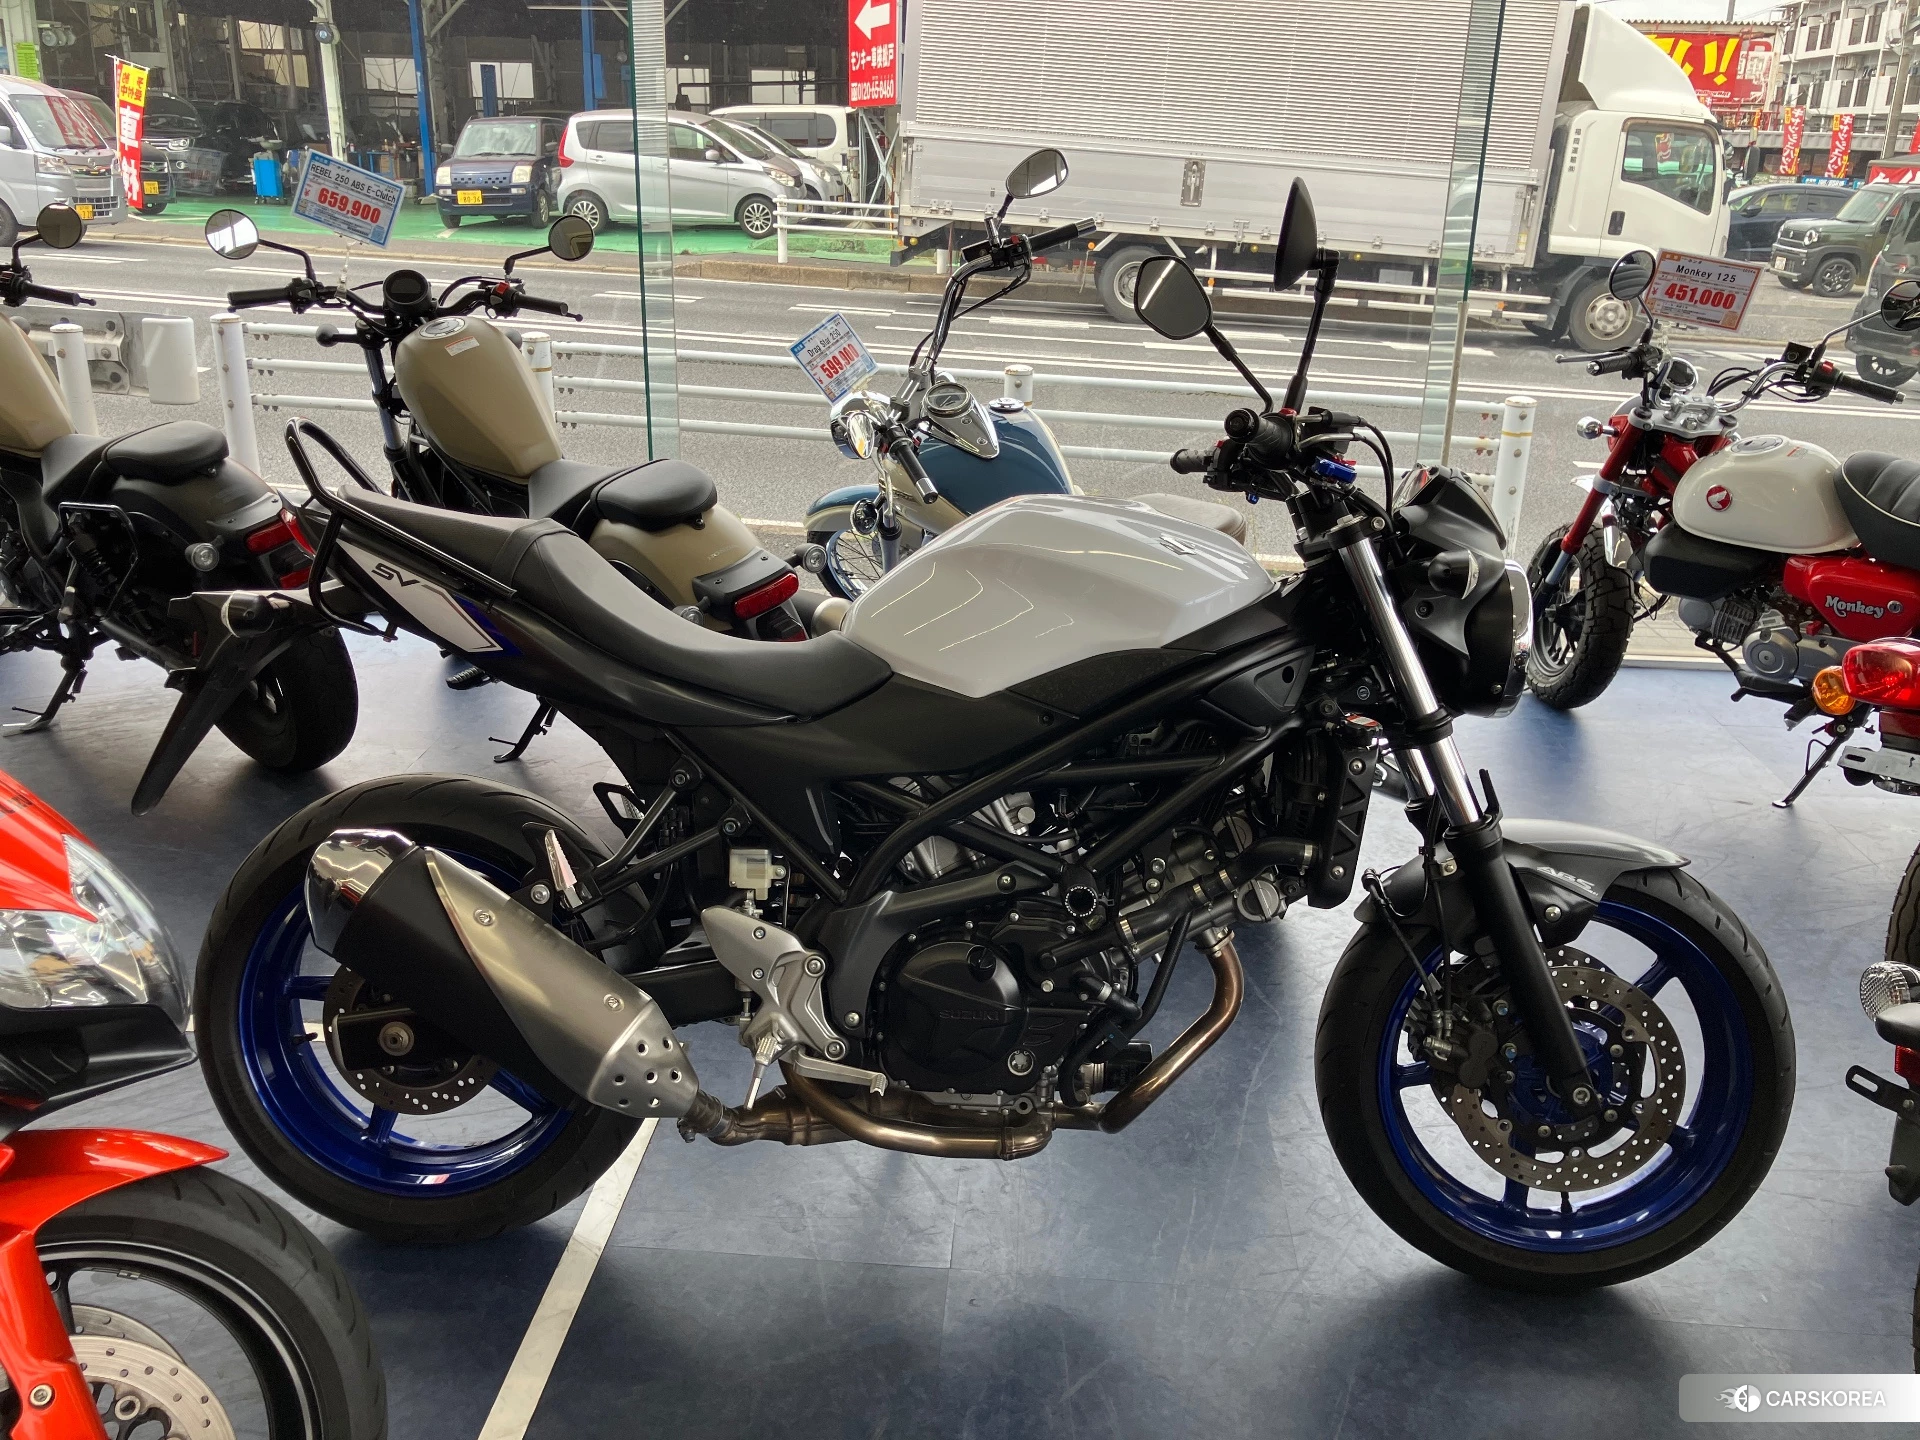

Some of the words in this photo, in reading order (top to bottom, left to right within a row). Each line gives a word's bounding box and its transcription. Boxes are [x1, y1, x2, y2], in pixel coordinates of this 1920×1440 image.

[851, 43, 894, 71] モンキー車検松戸
[857, 79, 894, 101] 0120-65-8460
[310, 163, 332, 179] REBEL
[334, 173, 350, 185] 250
[351, 179, 366, 191] ABS
[366, 185, 396, 204] E-Clutch
[317, 187, 381, 224] 659,900
[1675, 264, 1713, 280] Monkey
[1717, 272, 1737, 283] 125
[1664, 282, 1737, 310] 451,000
[807, 345, 822, 358] Drag
[371, 562, 420, 587] SV
[1824, 595, 1885, 618] Monkey
[1536, 866, 1596, 891] ABS
[939, 1009, 1000, 1021] SUZUKI
